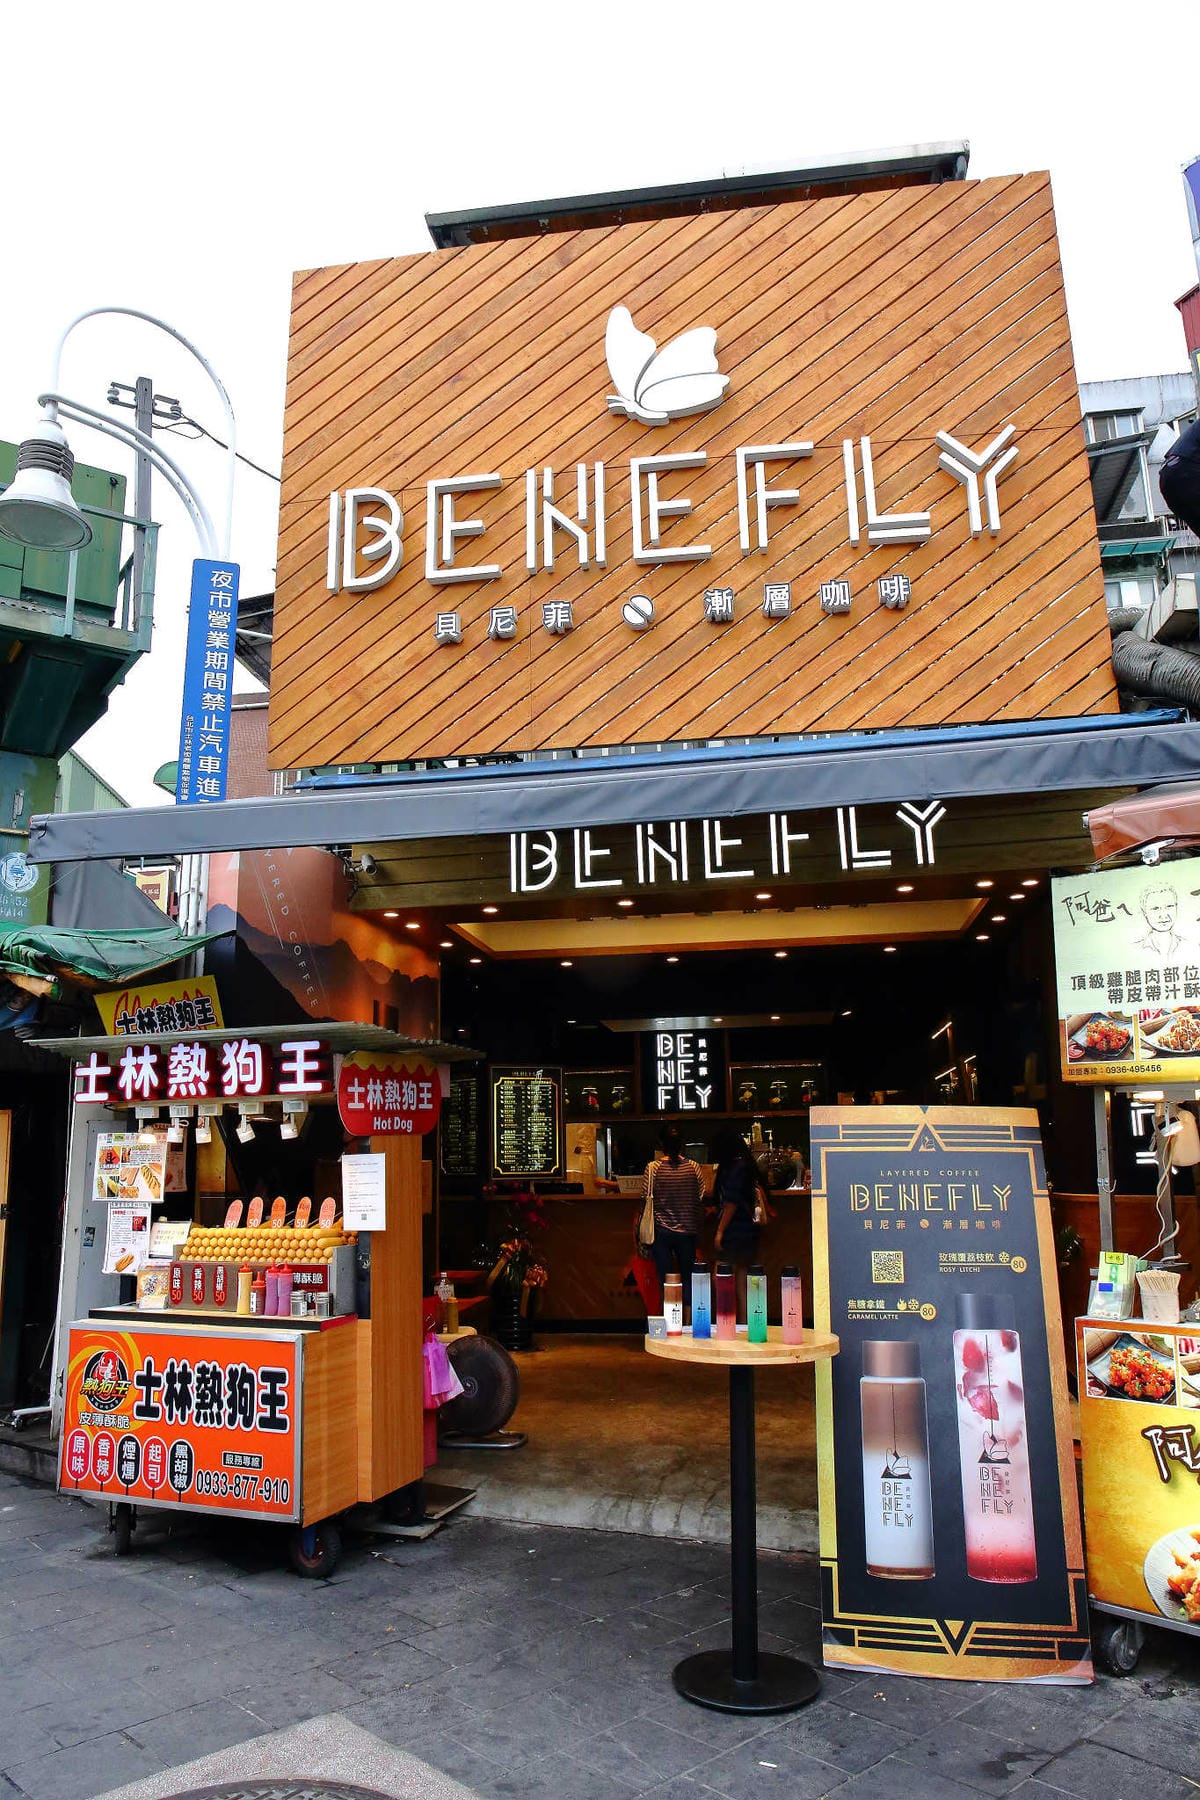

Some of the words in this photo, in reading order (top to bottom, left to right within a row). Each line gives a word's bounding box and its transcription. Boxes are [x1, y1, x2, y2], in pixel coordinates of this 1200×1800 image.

[326, 423, 1019, 595] BENEFLY
[433, 601, 574, 645] 貝尼菲
[703, 573, 913, 622] 漸層咖啡
[196, 570, 234, 802] 夜市營業期間禁止汽車進
[510, 800, 947, 893] BENEFLY
[289, 930, 319, 1008] COFFEE
[1070, 965, 1200, 991] 頂級雞腿肉部位
[115, 995, 216, 1035] 士林熱狗王
[657, 1033, 694, 1057] BE
[75, 1038, 324, 1102] 士林熱狗王
[657, 1060, 695, 1084] NE
[347, 1077, 433, 1111] 士林熱狗王
[657, 1084, 712, 1110] FLY
[373, 1116, 392, 1130] Hot
[394, 1116, 413, 1132] Dog
[880, 1169, 929, 1177] LAYERED
[939, 1169, 980, 1177] COFFEE
[849, 1183, 1013, 1212] BENEFLY
[1012, 1259, 1025, 1270] 80
[172, 1267, 182, 1290] 原味
[171, 1291, 182, 1301] 50
[193, 1291, 204, 1302] 50
[215, 1291, 225, 1302] 50
[922, 1307, 934, 1317] 80
[80, 1377, 132, 1398] 熱狗王
[133, 1356, 290, 1434] 士林熱狗王
[79, 1411, 131, 1429] 皮薄酥脆
[71, 1435, 86, 1474] 原味
[96, 1438, 111, 1482] 香辣
[121, 1440, 136, 1481] 煙燻
[148, 1442, 162, 1485] 起司
[173, 1444, 189, 1490] 黑胡椒
[195, 1469, 290, 1504] 0933-877-910
[882, 1512, 914, 1528] FLY
[981, 1498, 1014, 1515] FLY
